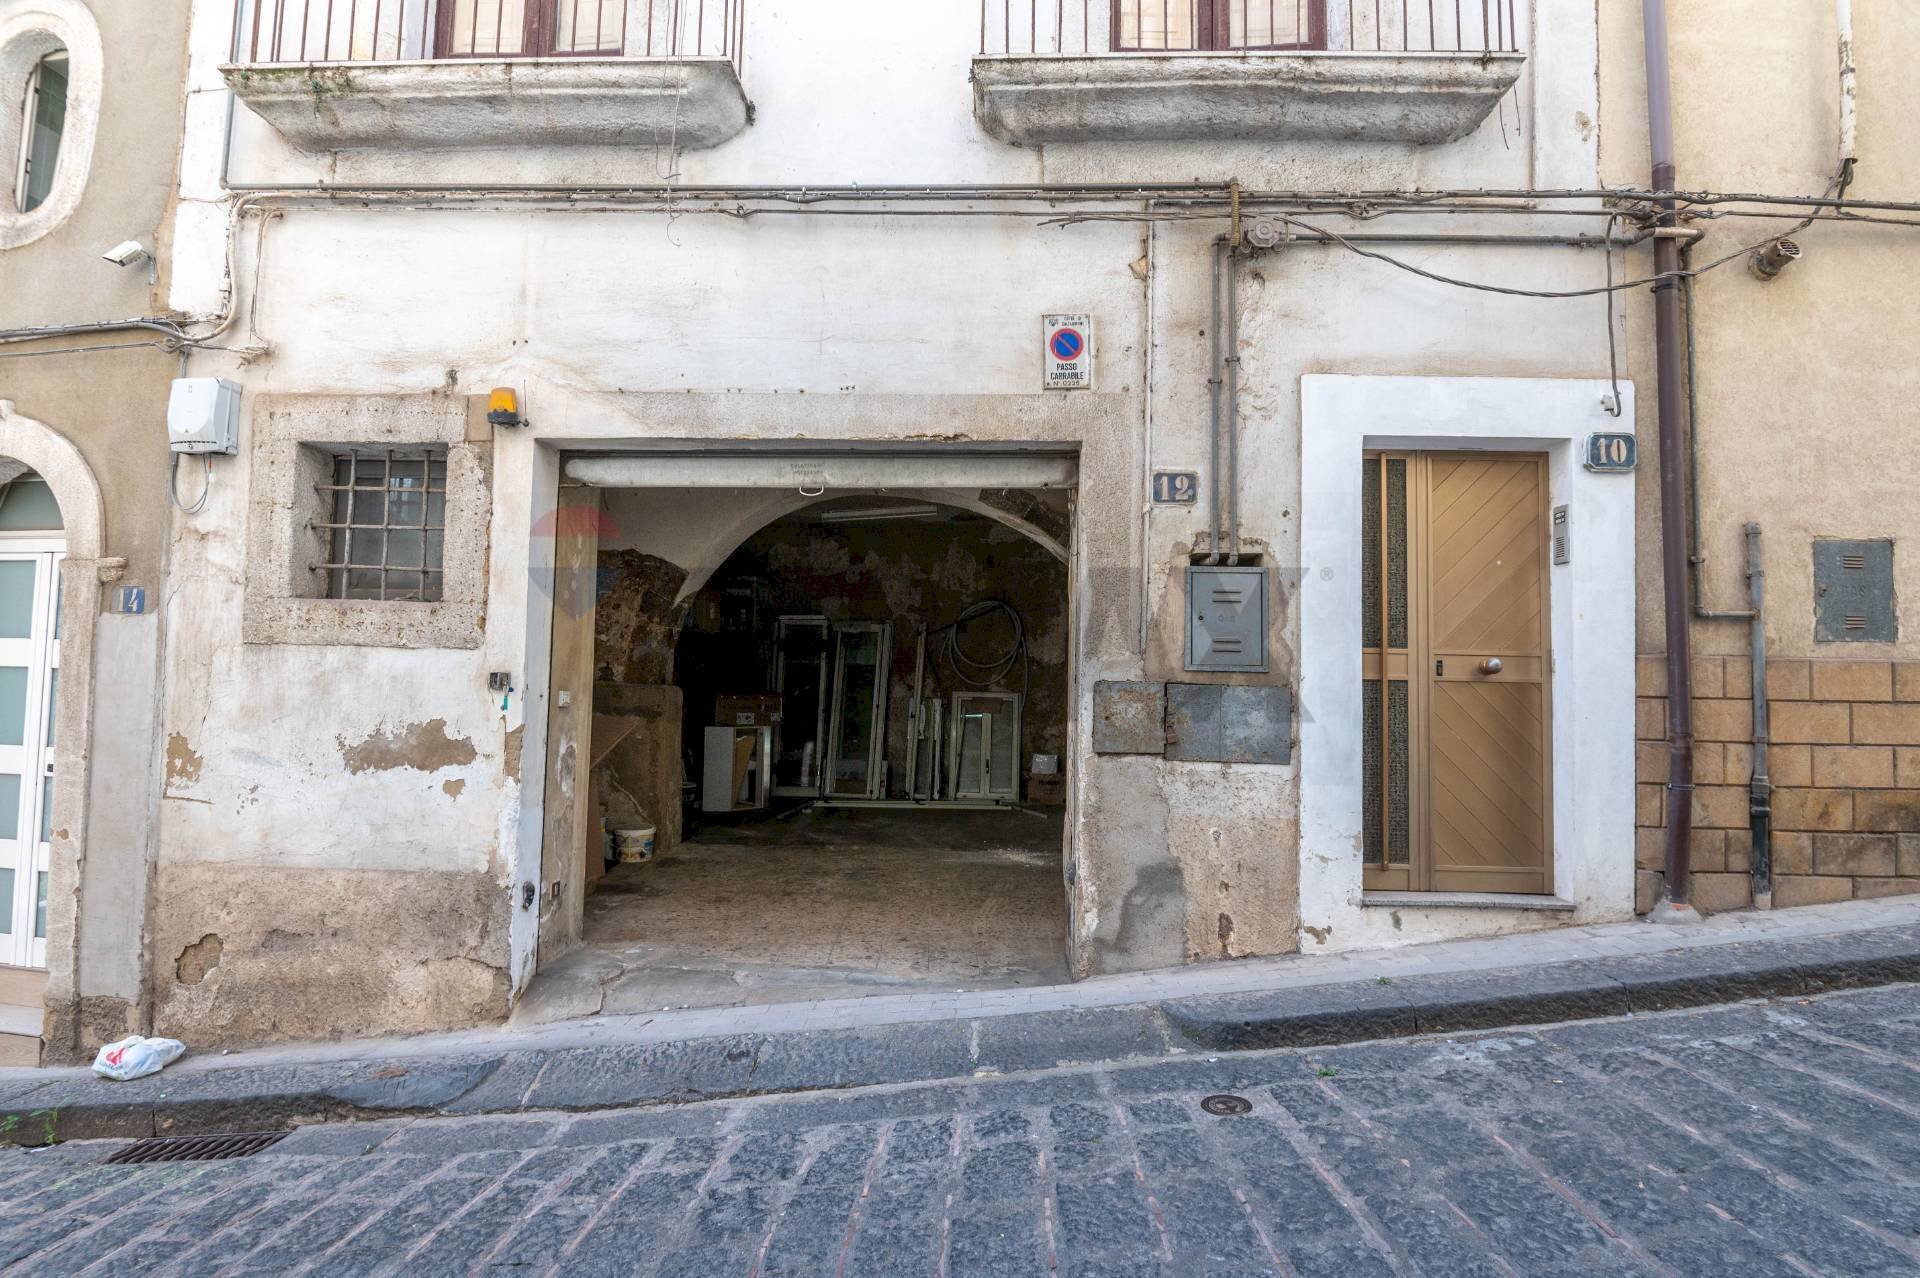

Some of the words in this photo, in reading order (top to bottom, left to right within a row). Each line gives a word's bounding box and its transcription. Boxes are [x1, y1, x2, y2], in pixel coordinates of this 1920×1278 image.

[1056, 362, 1078, 371] PASSO
[1050, 371, 1085, 380] CARRABILE
[1596, 437, 1627, 464] 10
[1159, 475, 1189, 501] 12
